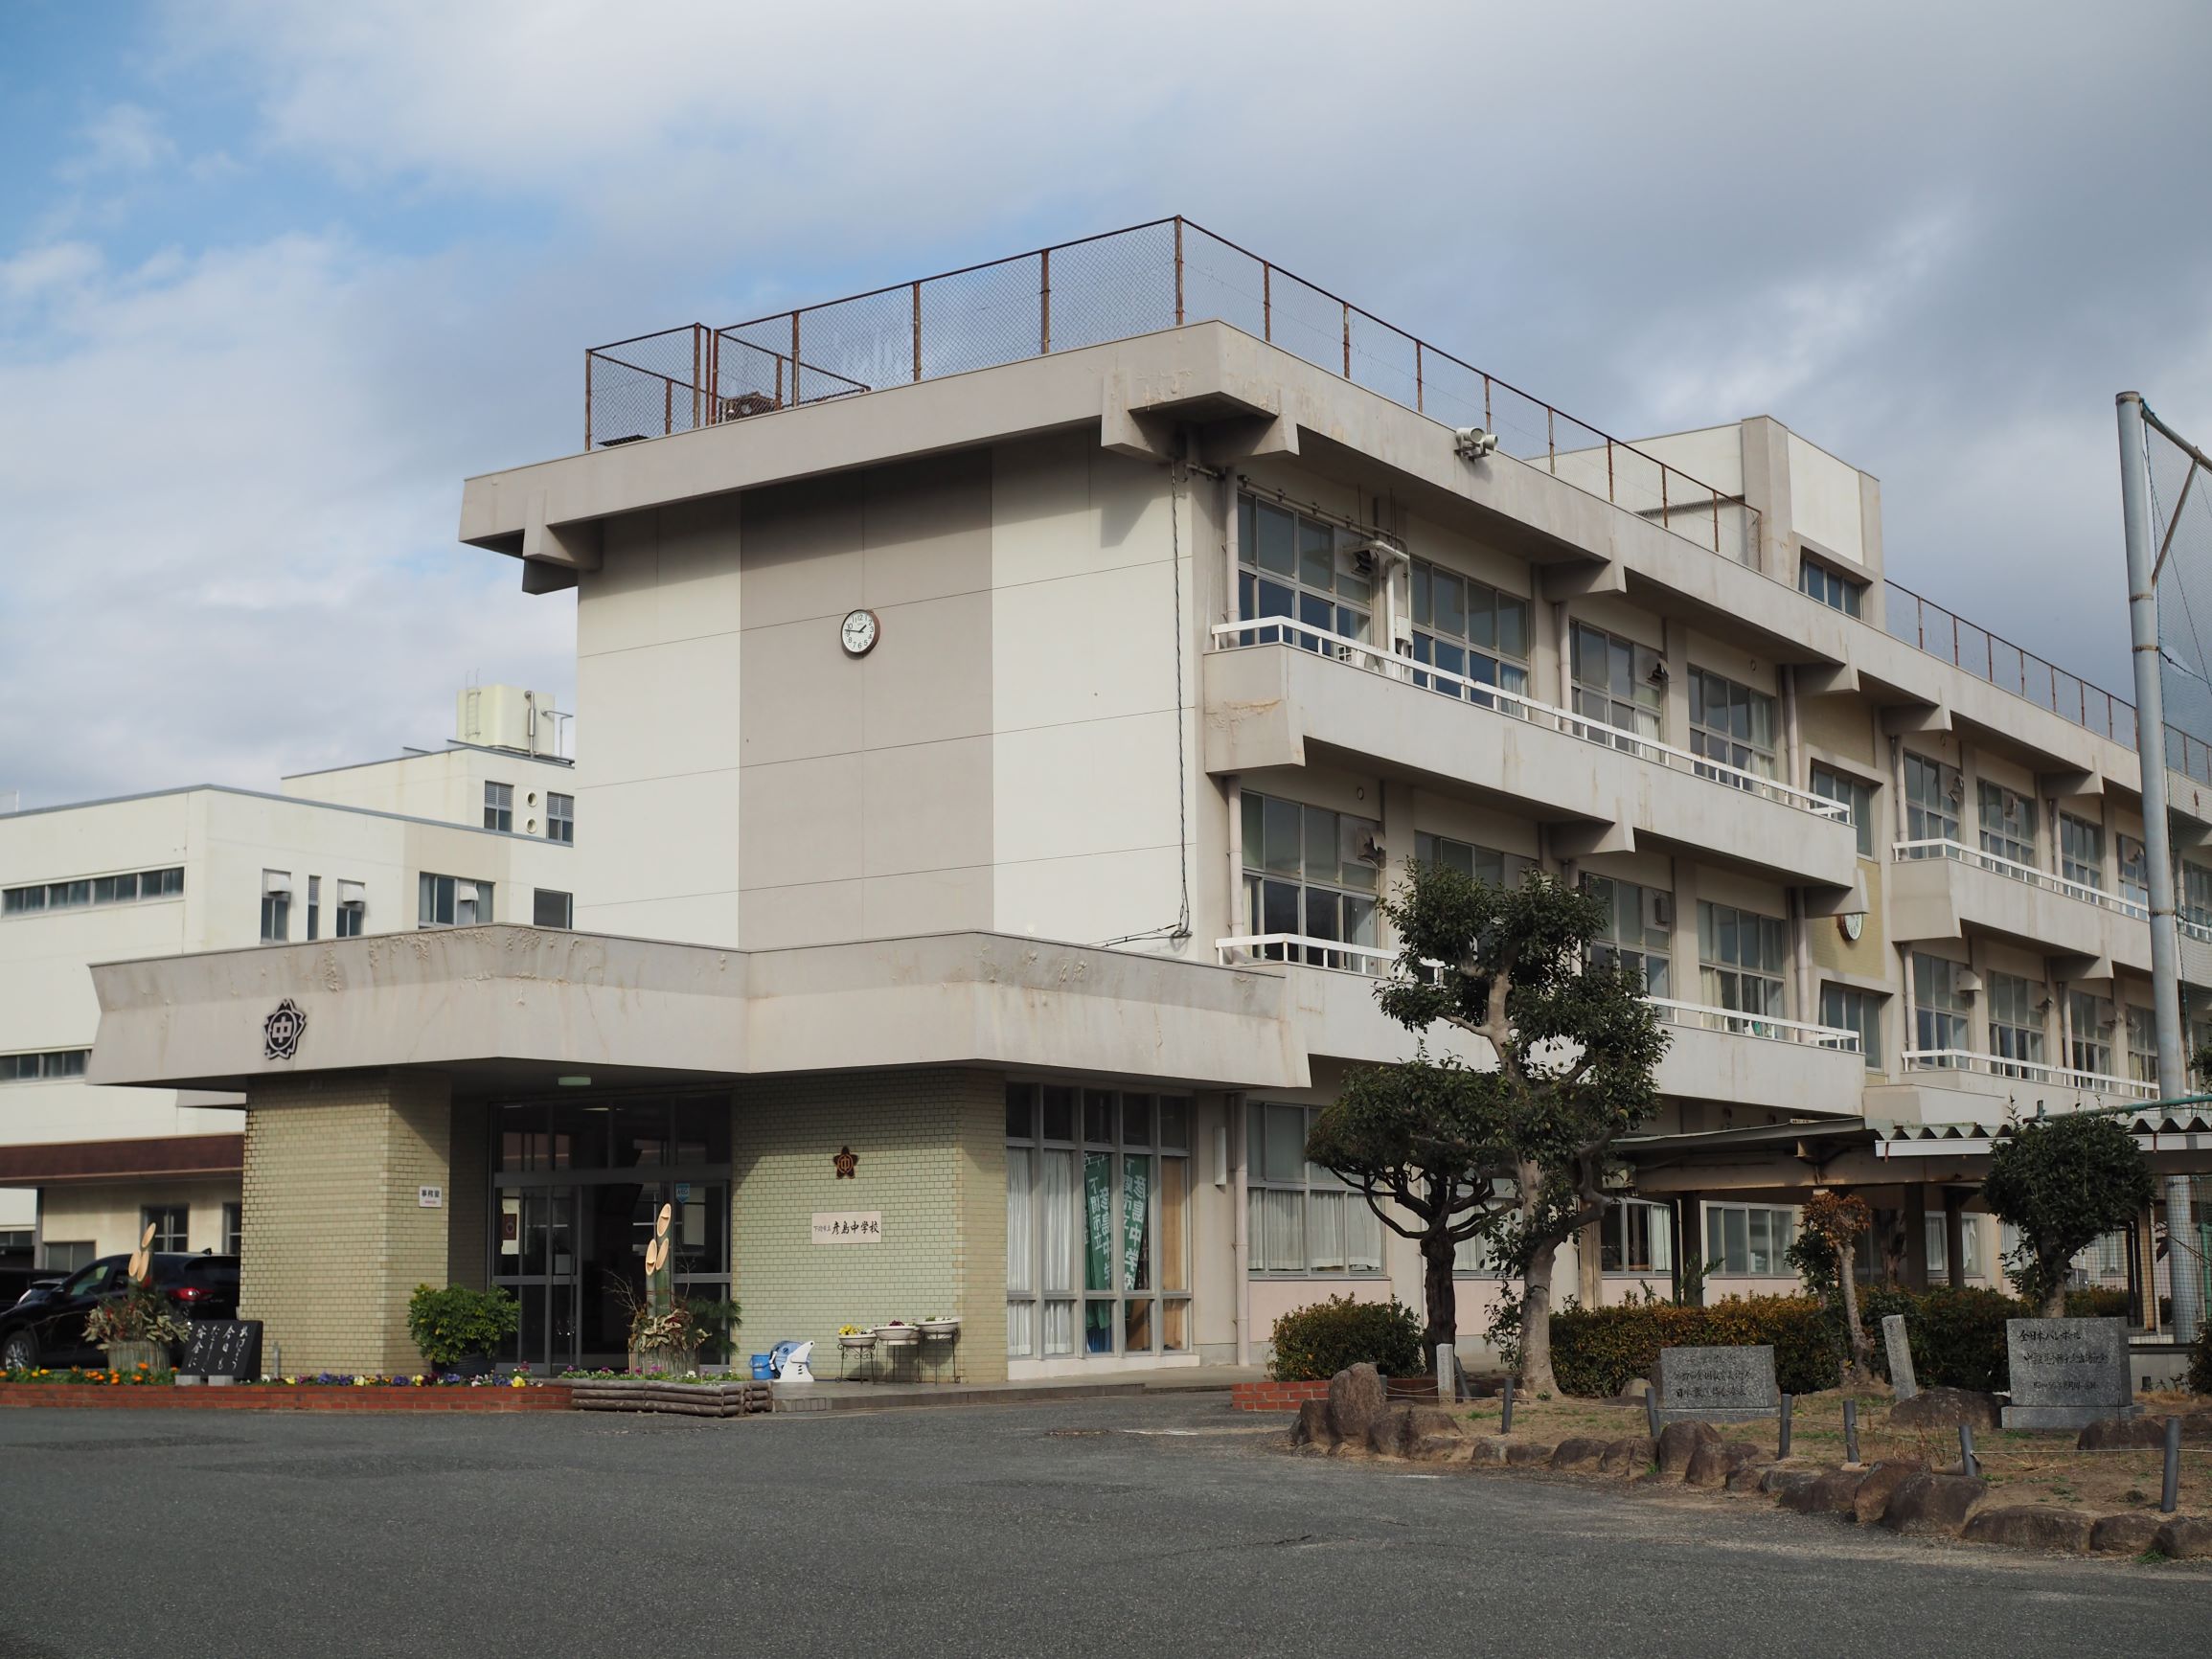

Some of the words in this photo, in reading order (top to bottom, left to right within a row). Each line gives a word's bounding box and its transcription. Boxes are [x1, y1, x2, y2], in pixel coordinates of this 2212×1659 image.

[272, 1015, 293, 1044] 中
[832, 1220, 880, 1236] 彦島中学校
